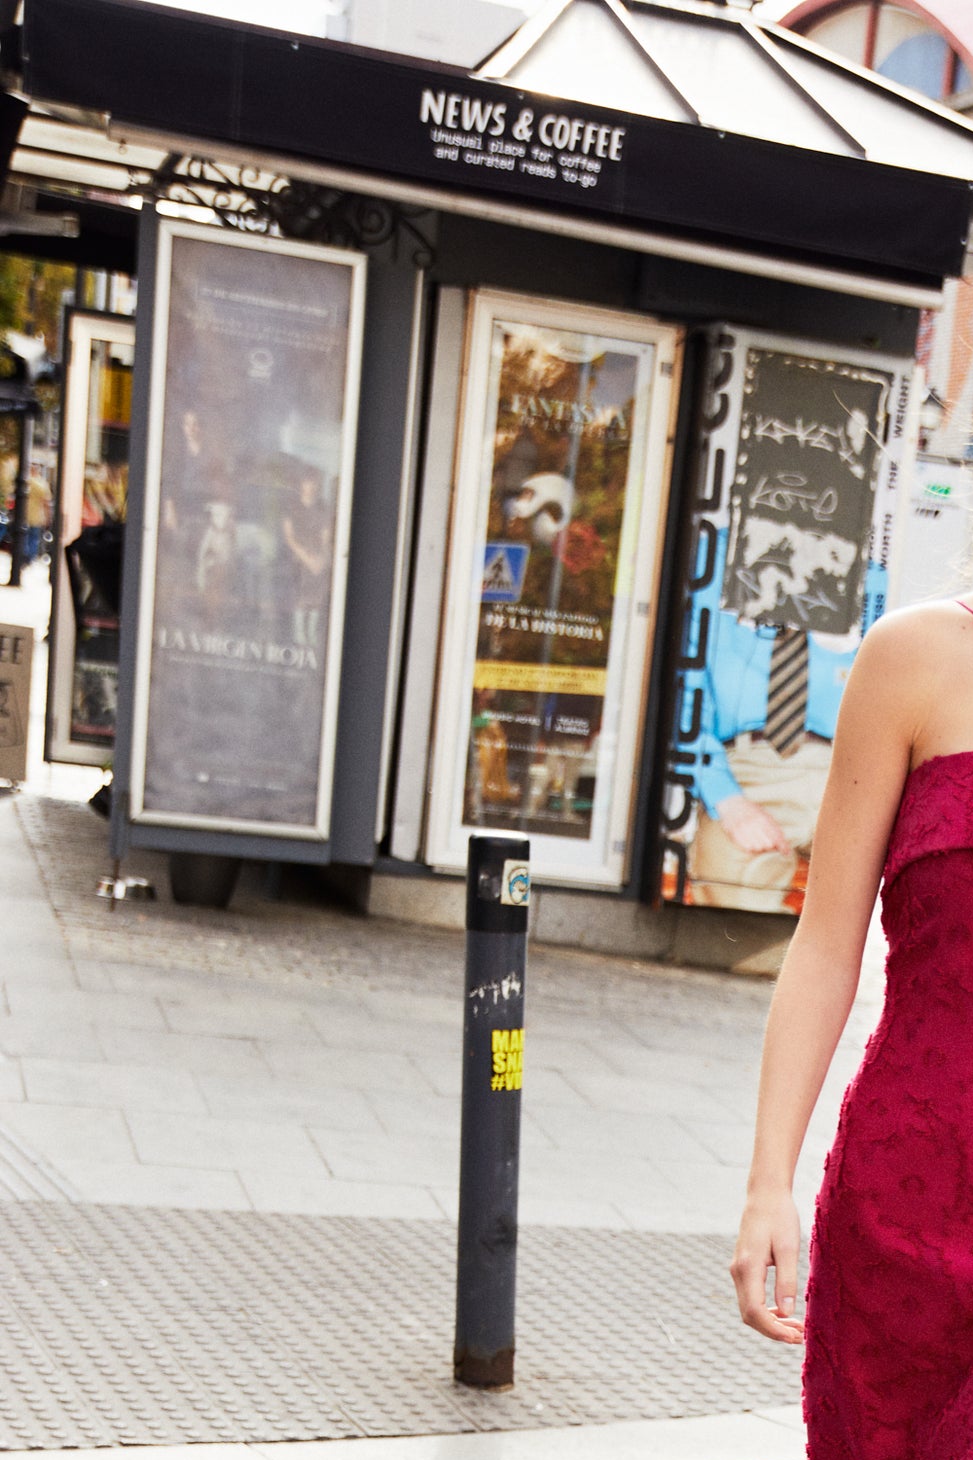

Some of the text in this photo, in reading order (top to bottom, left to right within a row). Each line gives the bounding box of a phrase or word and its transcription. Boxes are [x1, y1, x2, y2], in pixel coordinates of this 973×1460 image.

[421, 89, 626, 161] NEWS & COFFEE
[434, 145, 459, 161] and
[462, 151, 515, 171] curated
[519, 159, 556, 179] reads
[488, 138, 526, 159] place
[531, 145, 554, 163] for
[557, 153, 601, 173] coffee
[894, 376, 910, 438] WEIGHT
